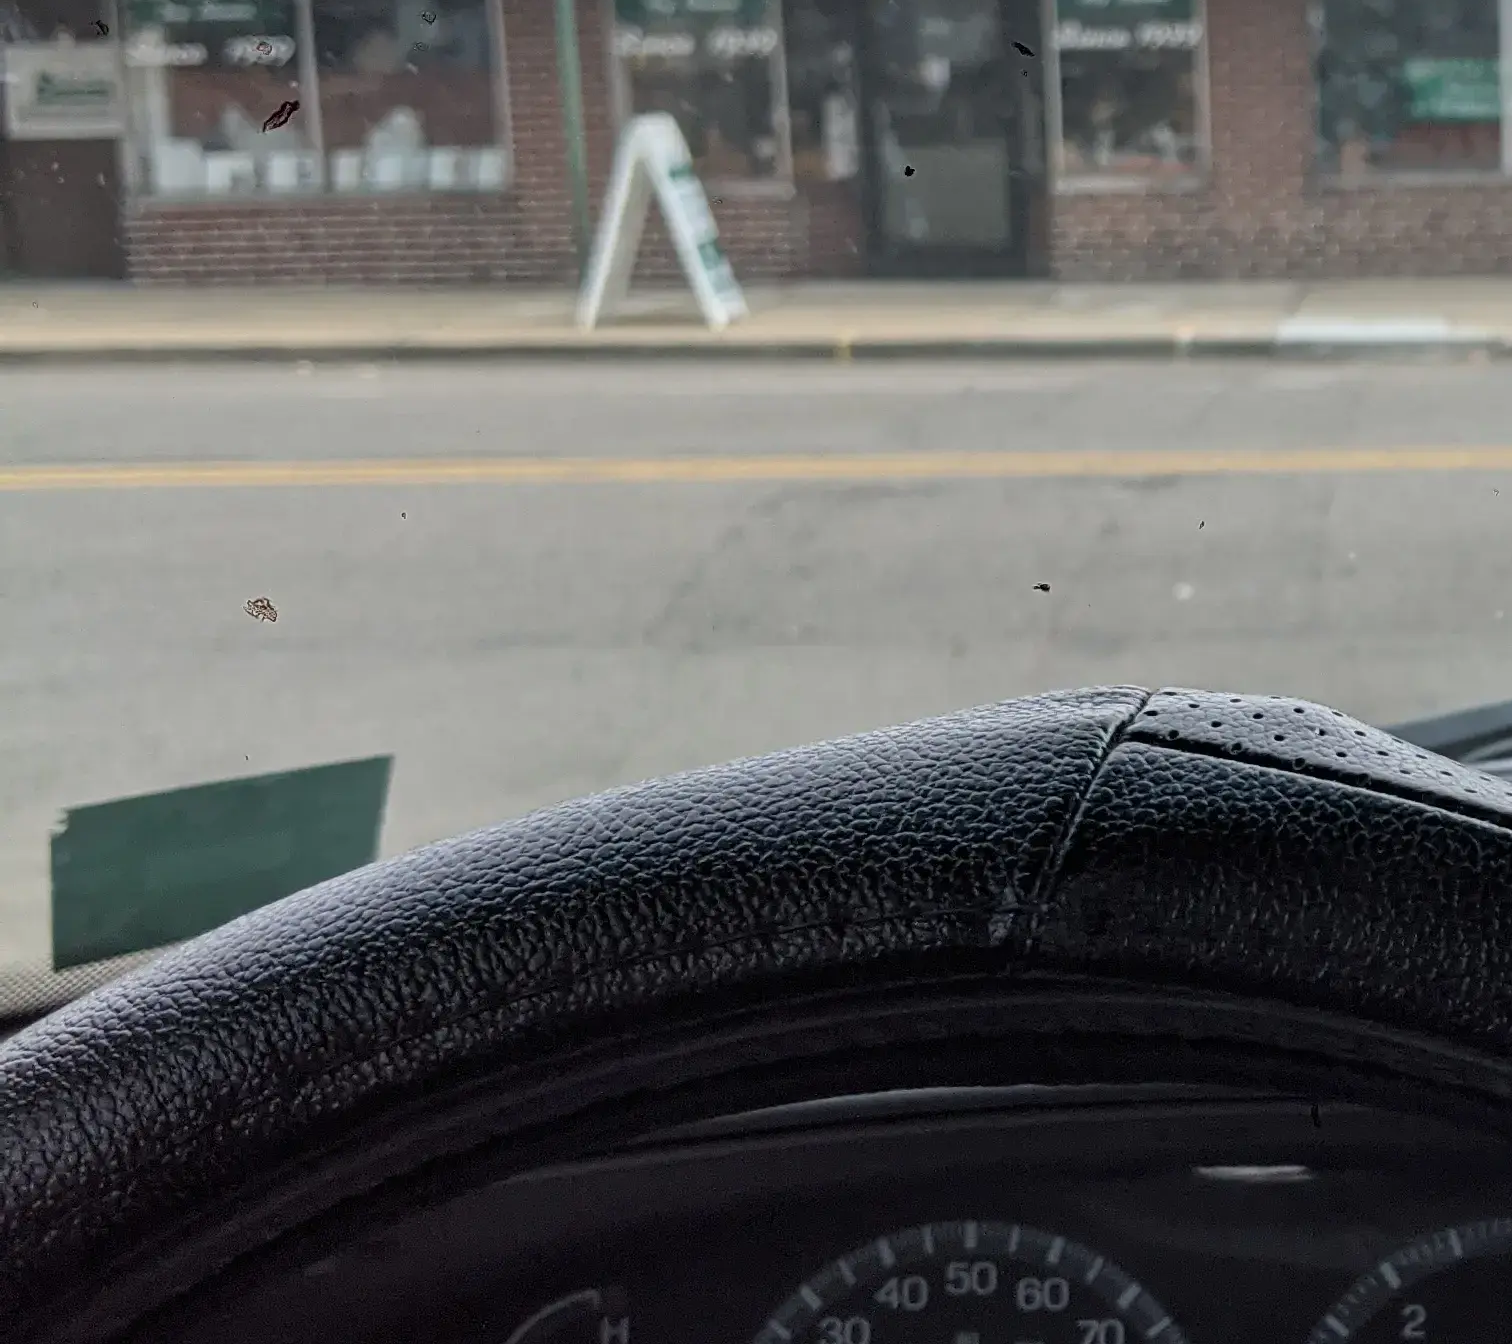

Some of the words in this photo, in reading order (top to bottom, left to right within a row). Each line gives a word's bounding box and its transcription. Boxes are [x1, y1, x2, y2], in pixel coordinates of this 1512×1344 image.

[875, 1275, 929, 1311] 40
[946, 1261, 998, 1295] 50
[1016, 1277, 1070, 1311] 60
[1402, 1304, 1427, 1339] 2
